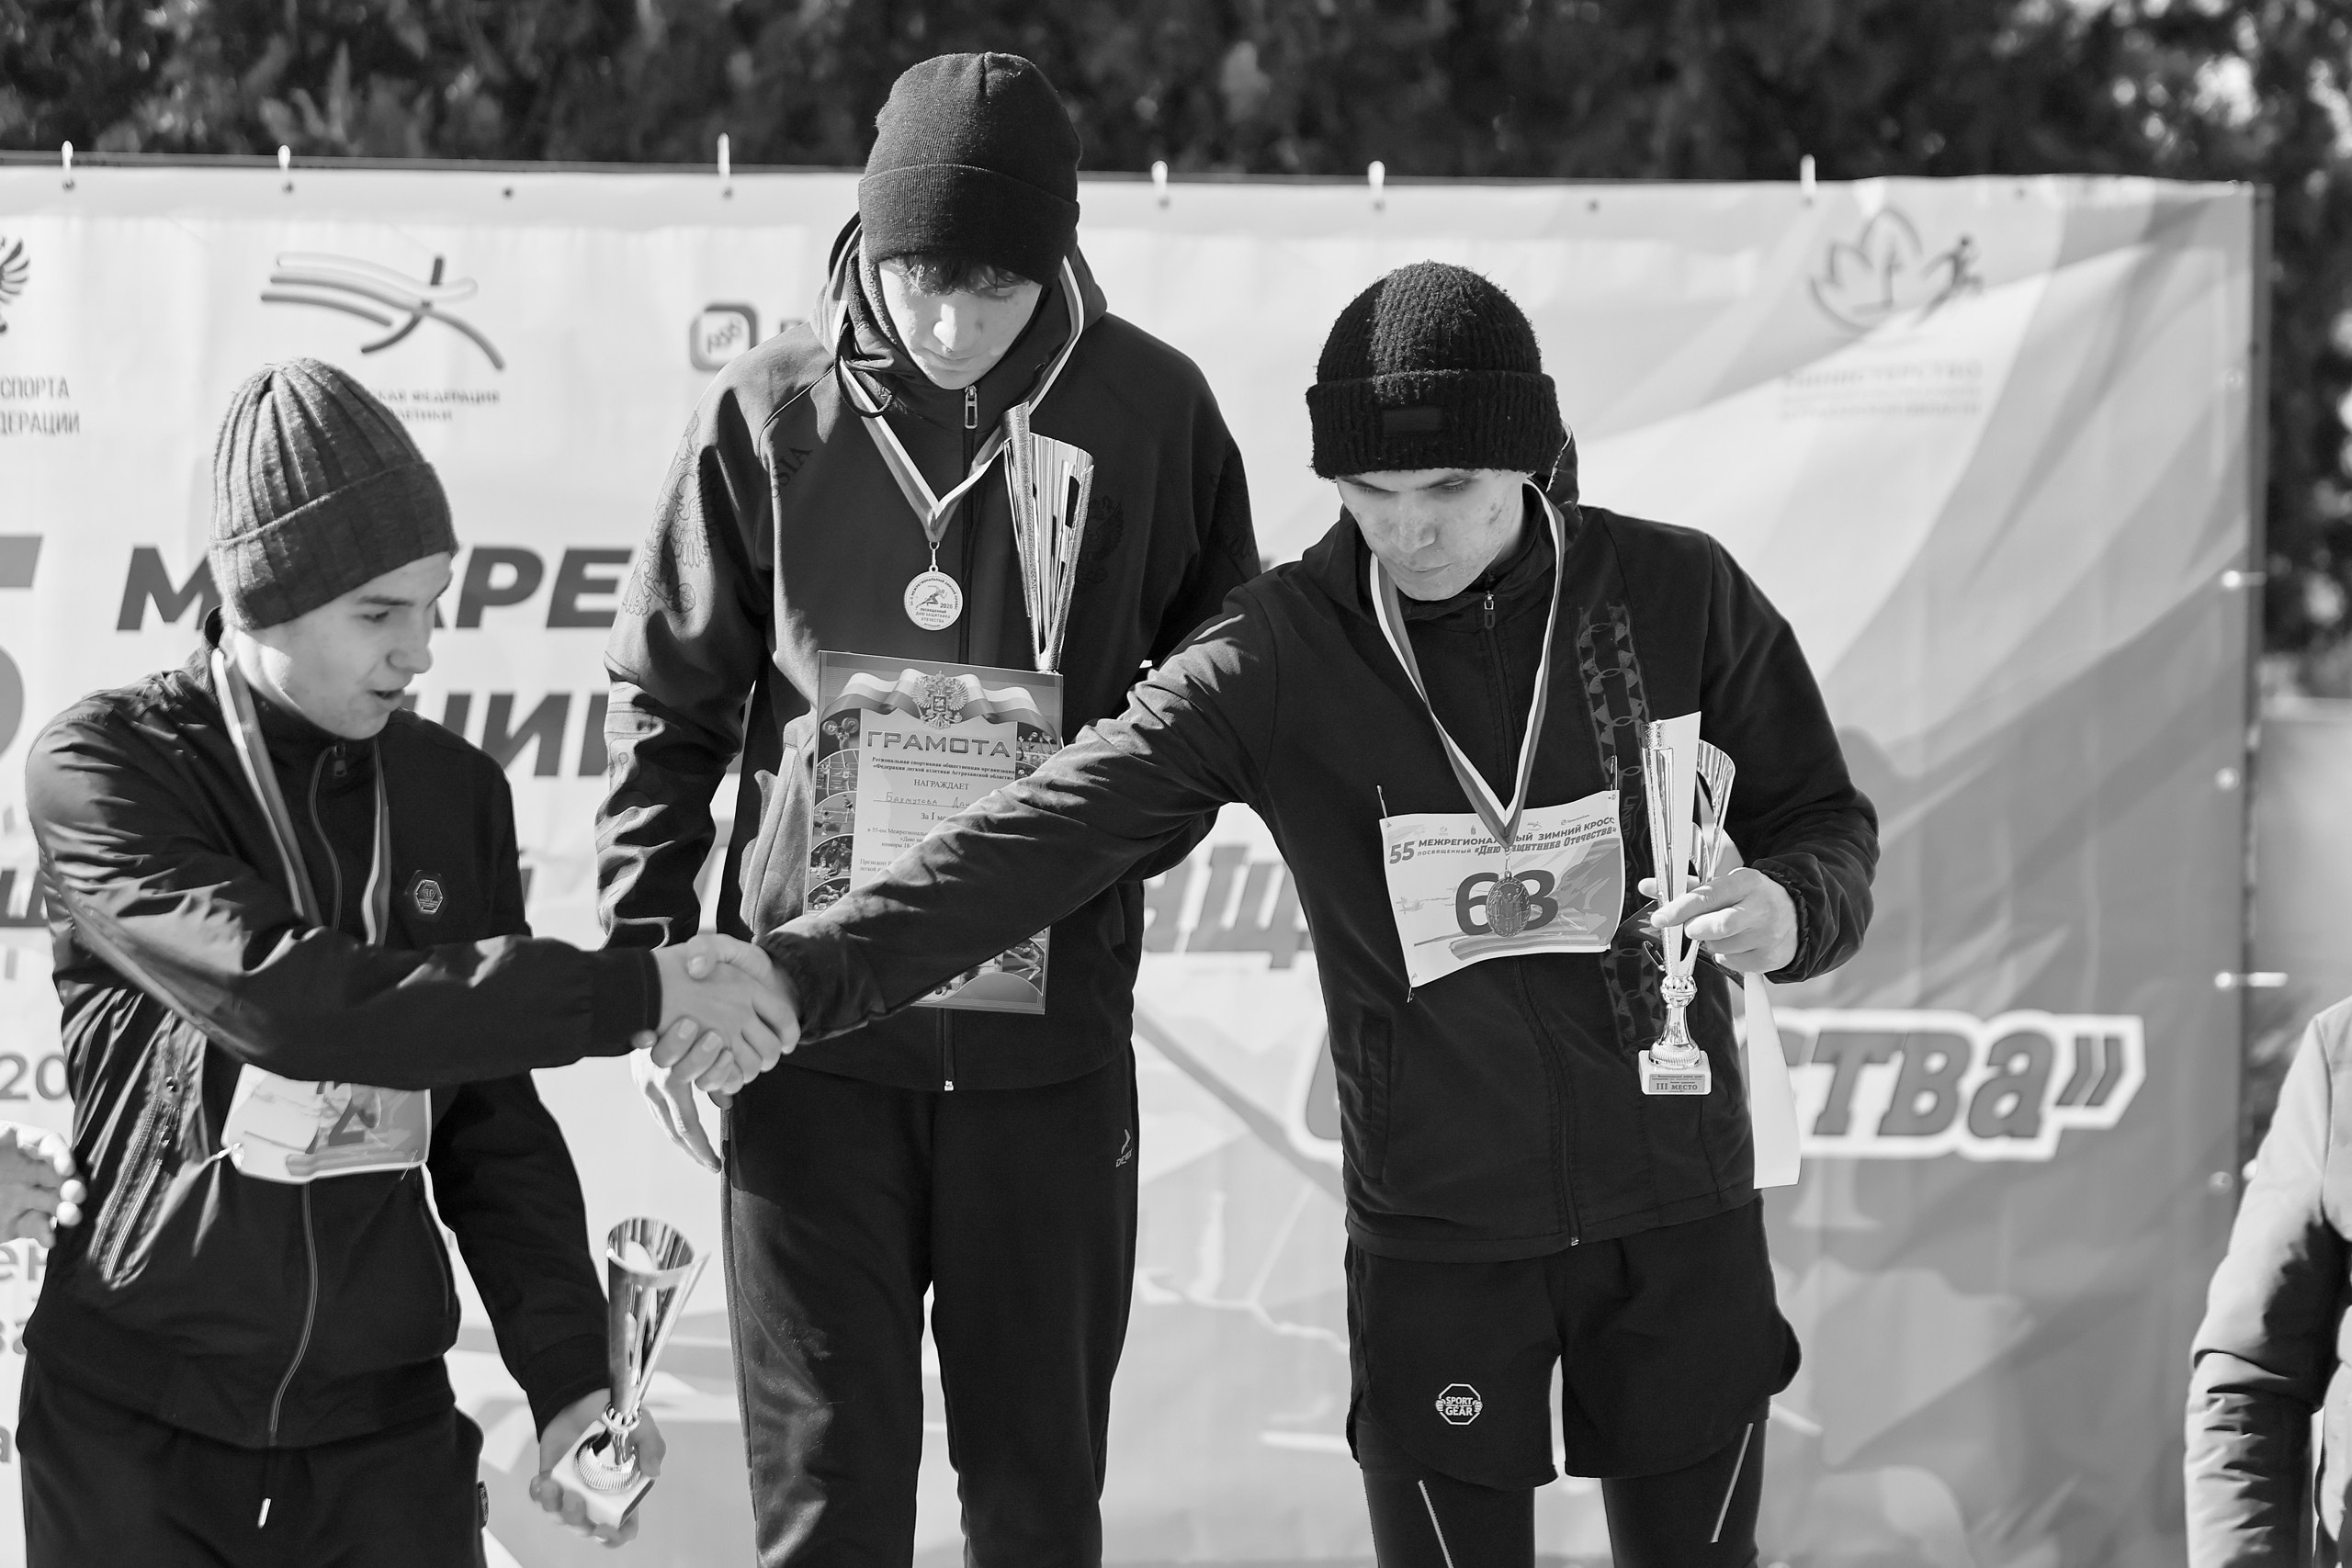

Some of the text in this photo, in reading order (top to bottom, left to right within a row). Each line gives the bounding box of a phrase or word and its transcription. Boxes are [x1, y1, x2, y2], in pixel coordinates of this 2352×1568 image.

[0, 376, 70, 398] СПОРТА
[867, 730, 1011, 758] ГРАМОТА
[914, 779, 970, 790] НАГРАЖДАЕТ
[921, 812, 929, 820] За
[1389, 841, 1416, 864] 55
[1538, 825, 1581, 840] ЗИМНИЙ
[1584, 817, 1615, 831] КРОСС
[1510, 840, 1562, 852] ащитника
[1656, 1082, 1668, 1090] III
[1445, 1396, 1474, 1404] SPORT
[1445, 1406, 1474, 1416] GEAR
